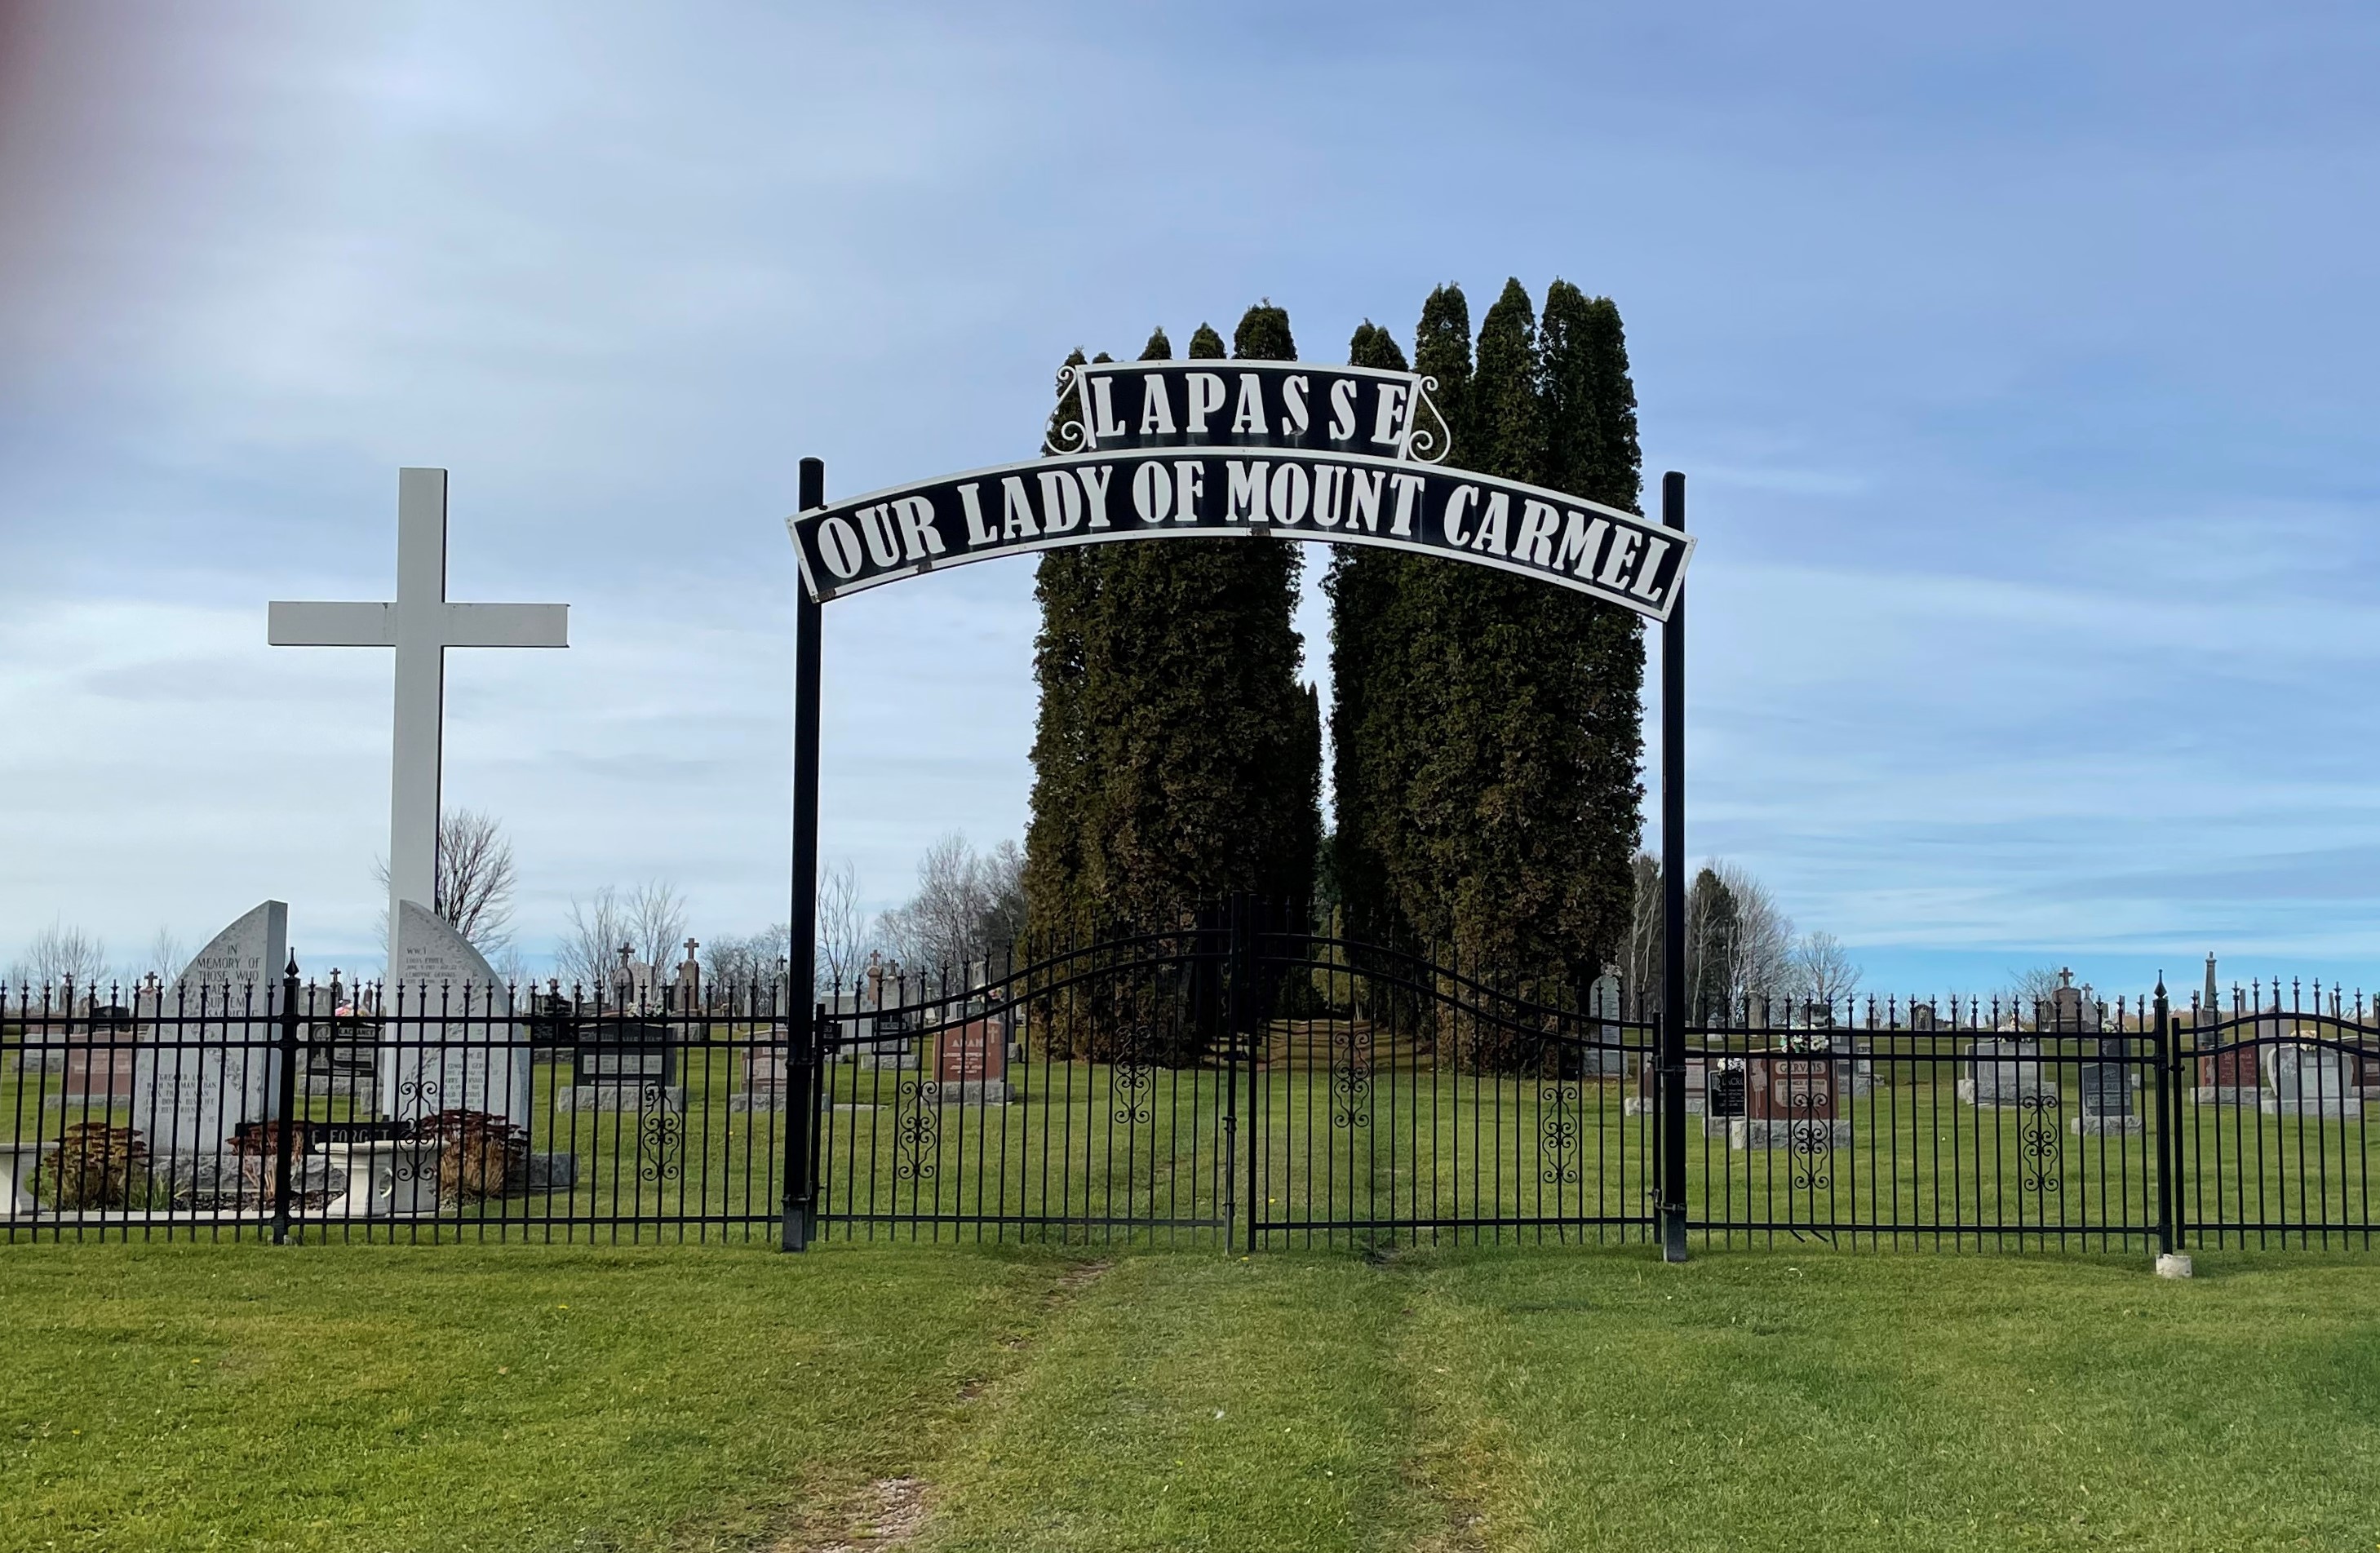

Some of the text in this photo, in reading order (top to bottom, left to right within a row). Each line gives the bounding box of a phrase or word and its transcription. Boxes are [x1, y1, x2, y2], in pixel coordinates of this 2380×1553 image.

[1090, 373, 1410, 445] LAPASSE
[818, 461, 1669, 601] OUR LADY OF MOUNT CARMEL
[228, 945, 237, 955] IN
[197, 958, 261, 969] MEMORY OF
[198, 971, 259, 982] THOSE WHO
